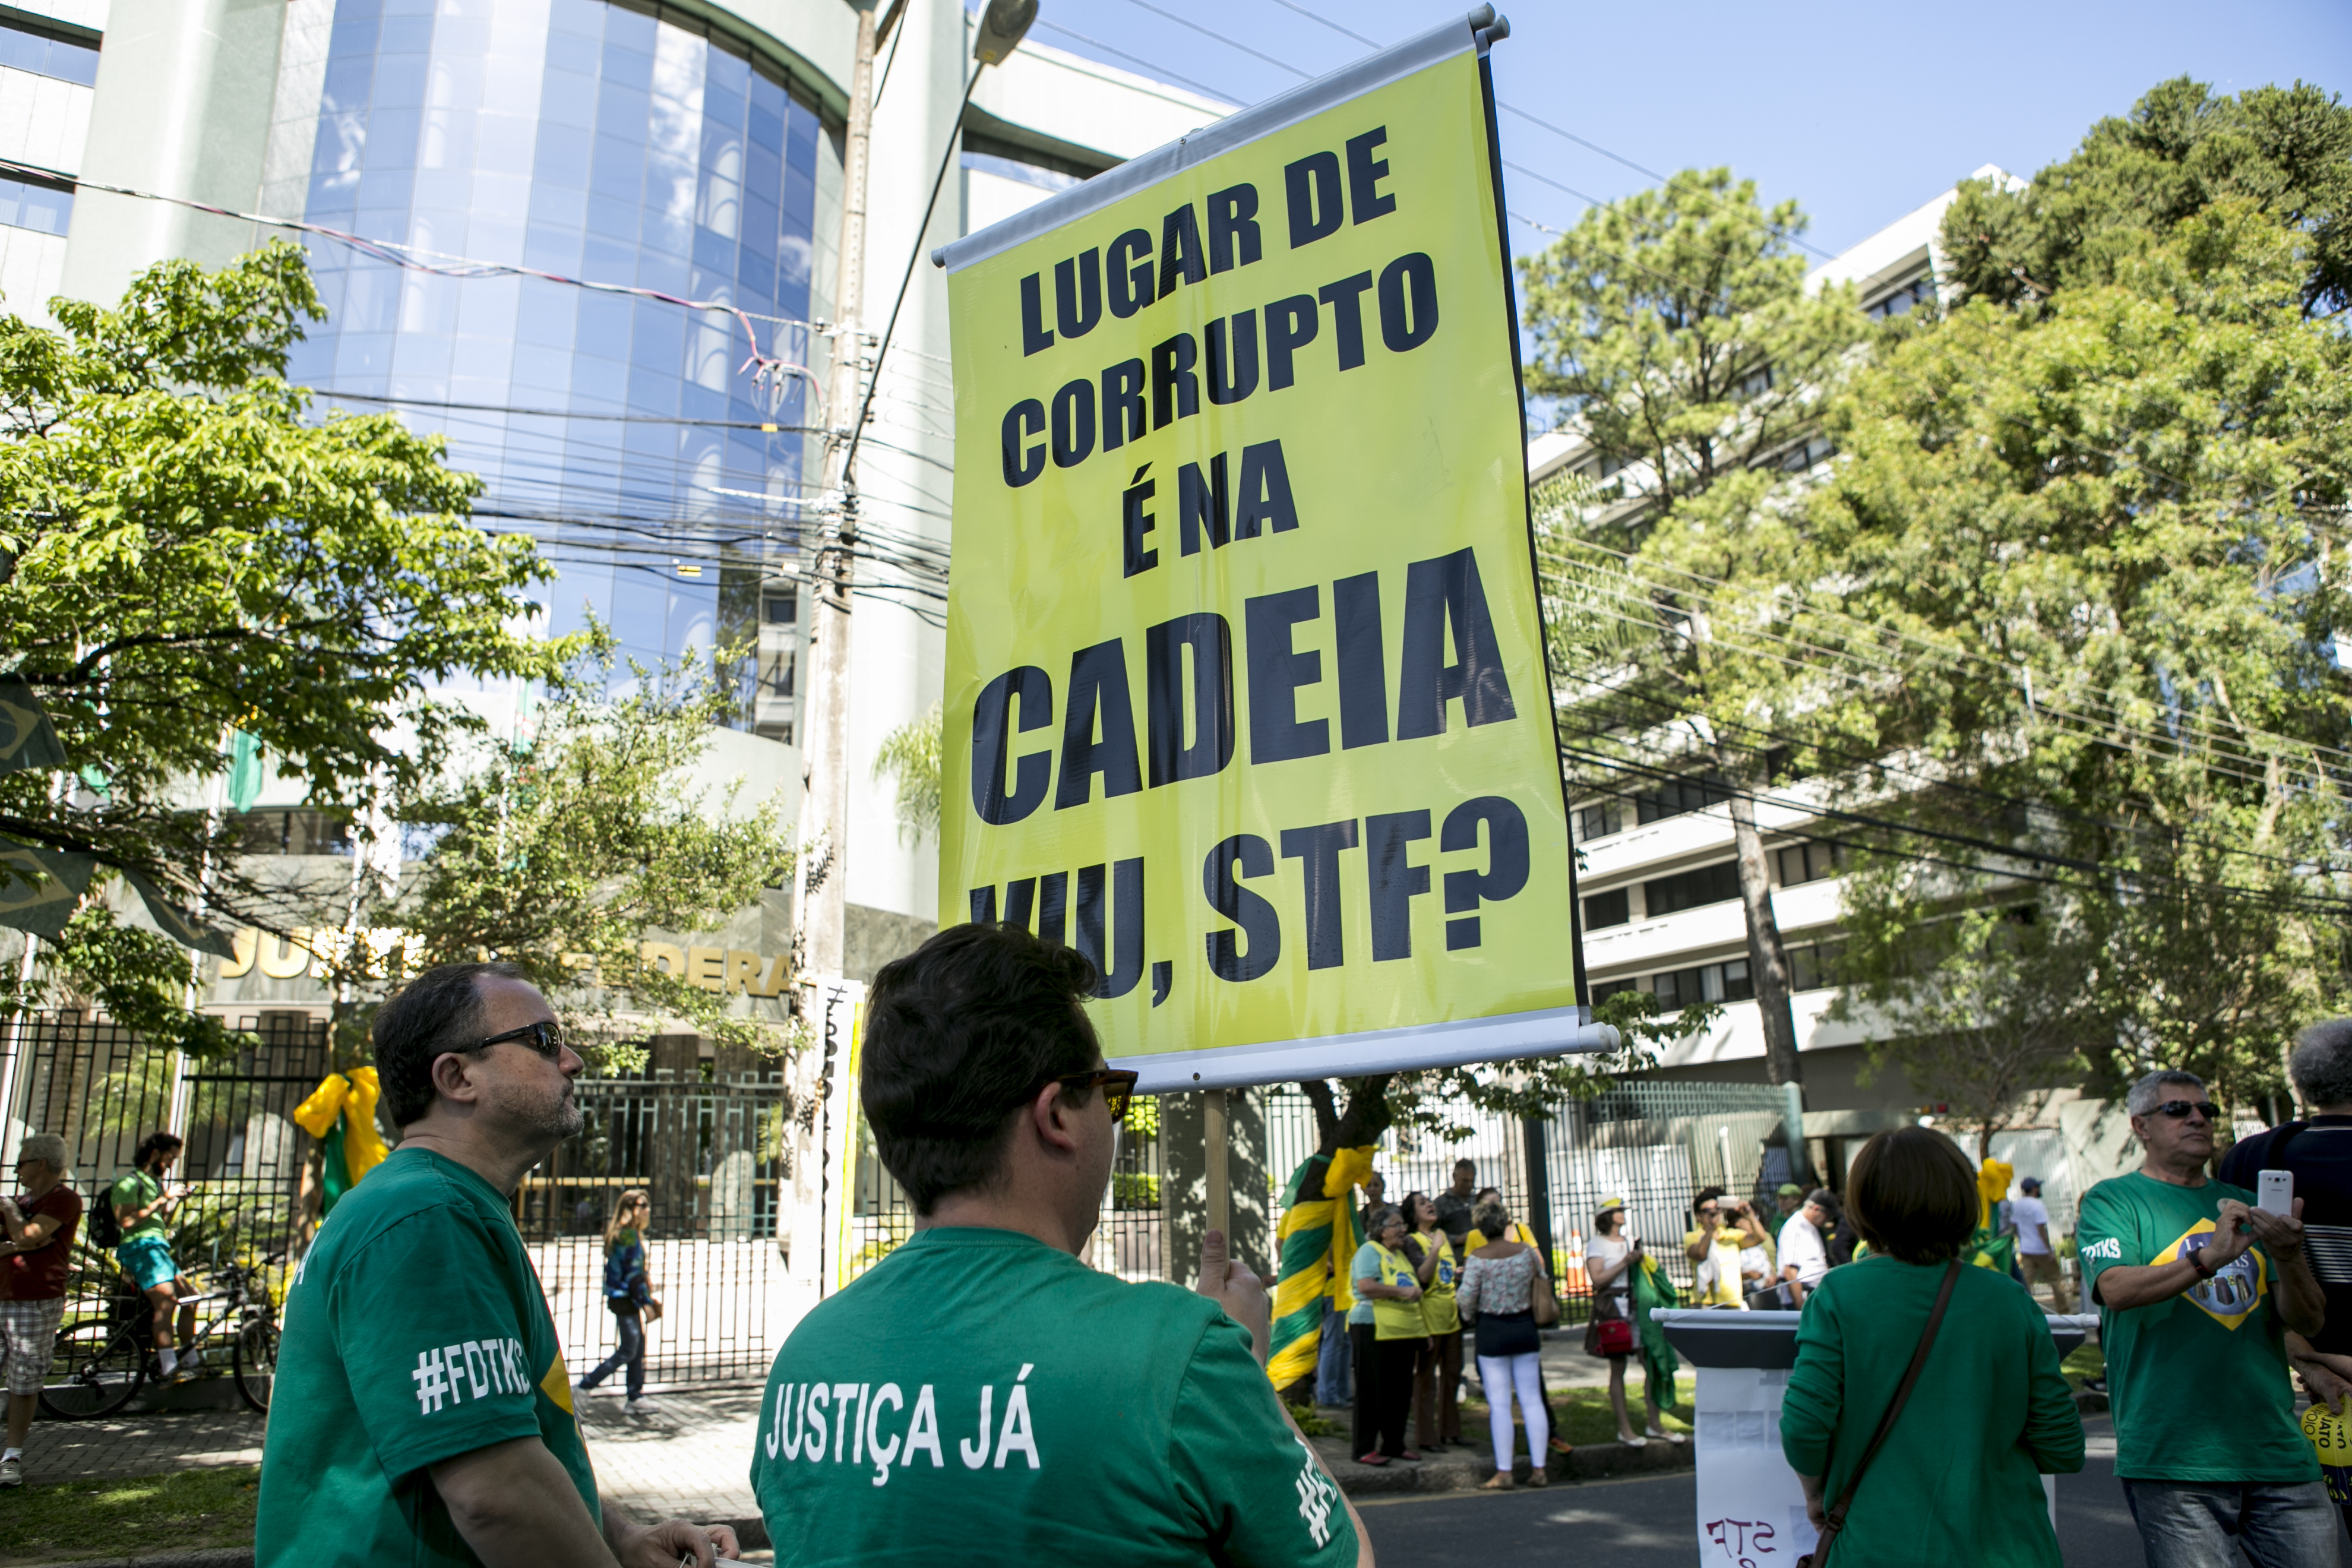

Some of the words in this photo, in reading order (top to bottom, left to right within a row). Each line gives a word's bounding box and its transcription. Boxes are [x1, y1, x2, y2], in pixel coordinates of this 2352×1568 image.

[1020, 182, 1262, 357] LUGAR
[1284, 124, 1397, 249] DE
[1001, 252, 1439, 488] CORRUPTO
[1122, 460, 1159, 579] É
[1177, 437, 1300, 558] NA
[971, 545, 1518, 826] CADEIA
[1203, 795, 1531, 982] STF?
[766, 1382, 944, 1486] JUSTIÇA
[959, 1363, 1041, 1470] JÁ
[2319, 1417, 2333, 1448] JATO
